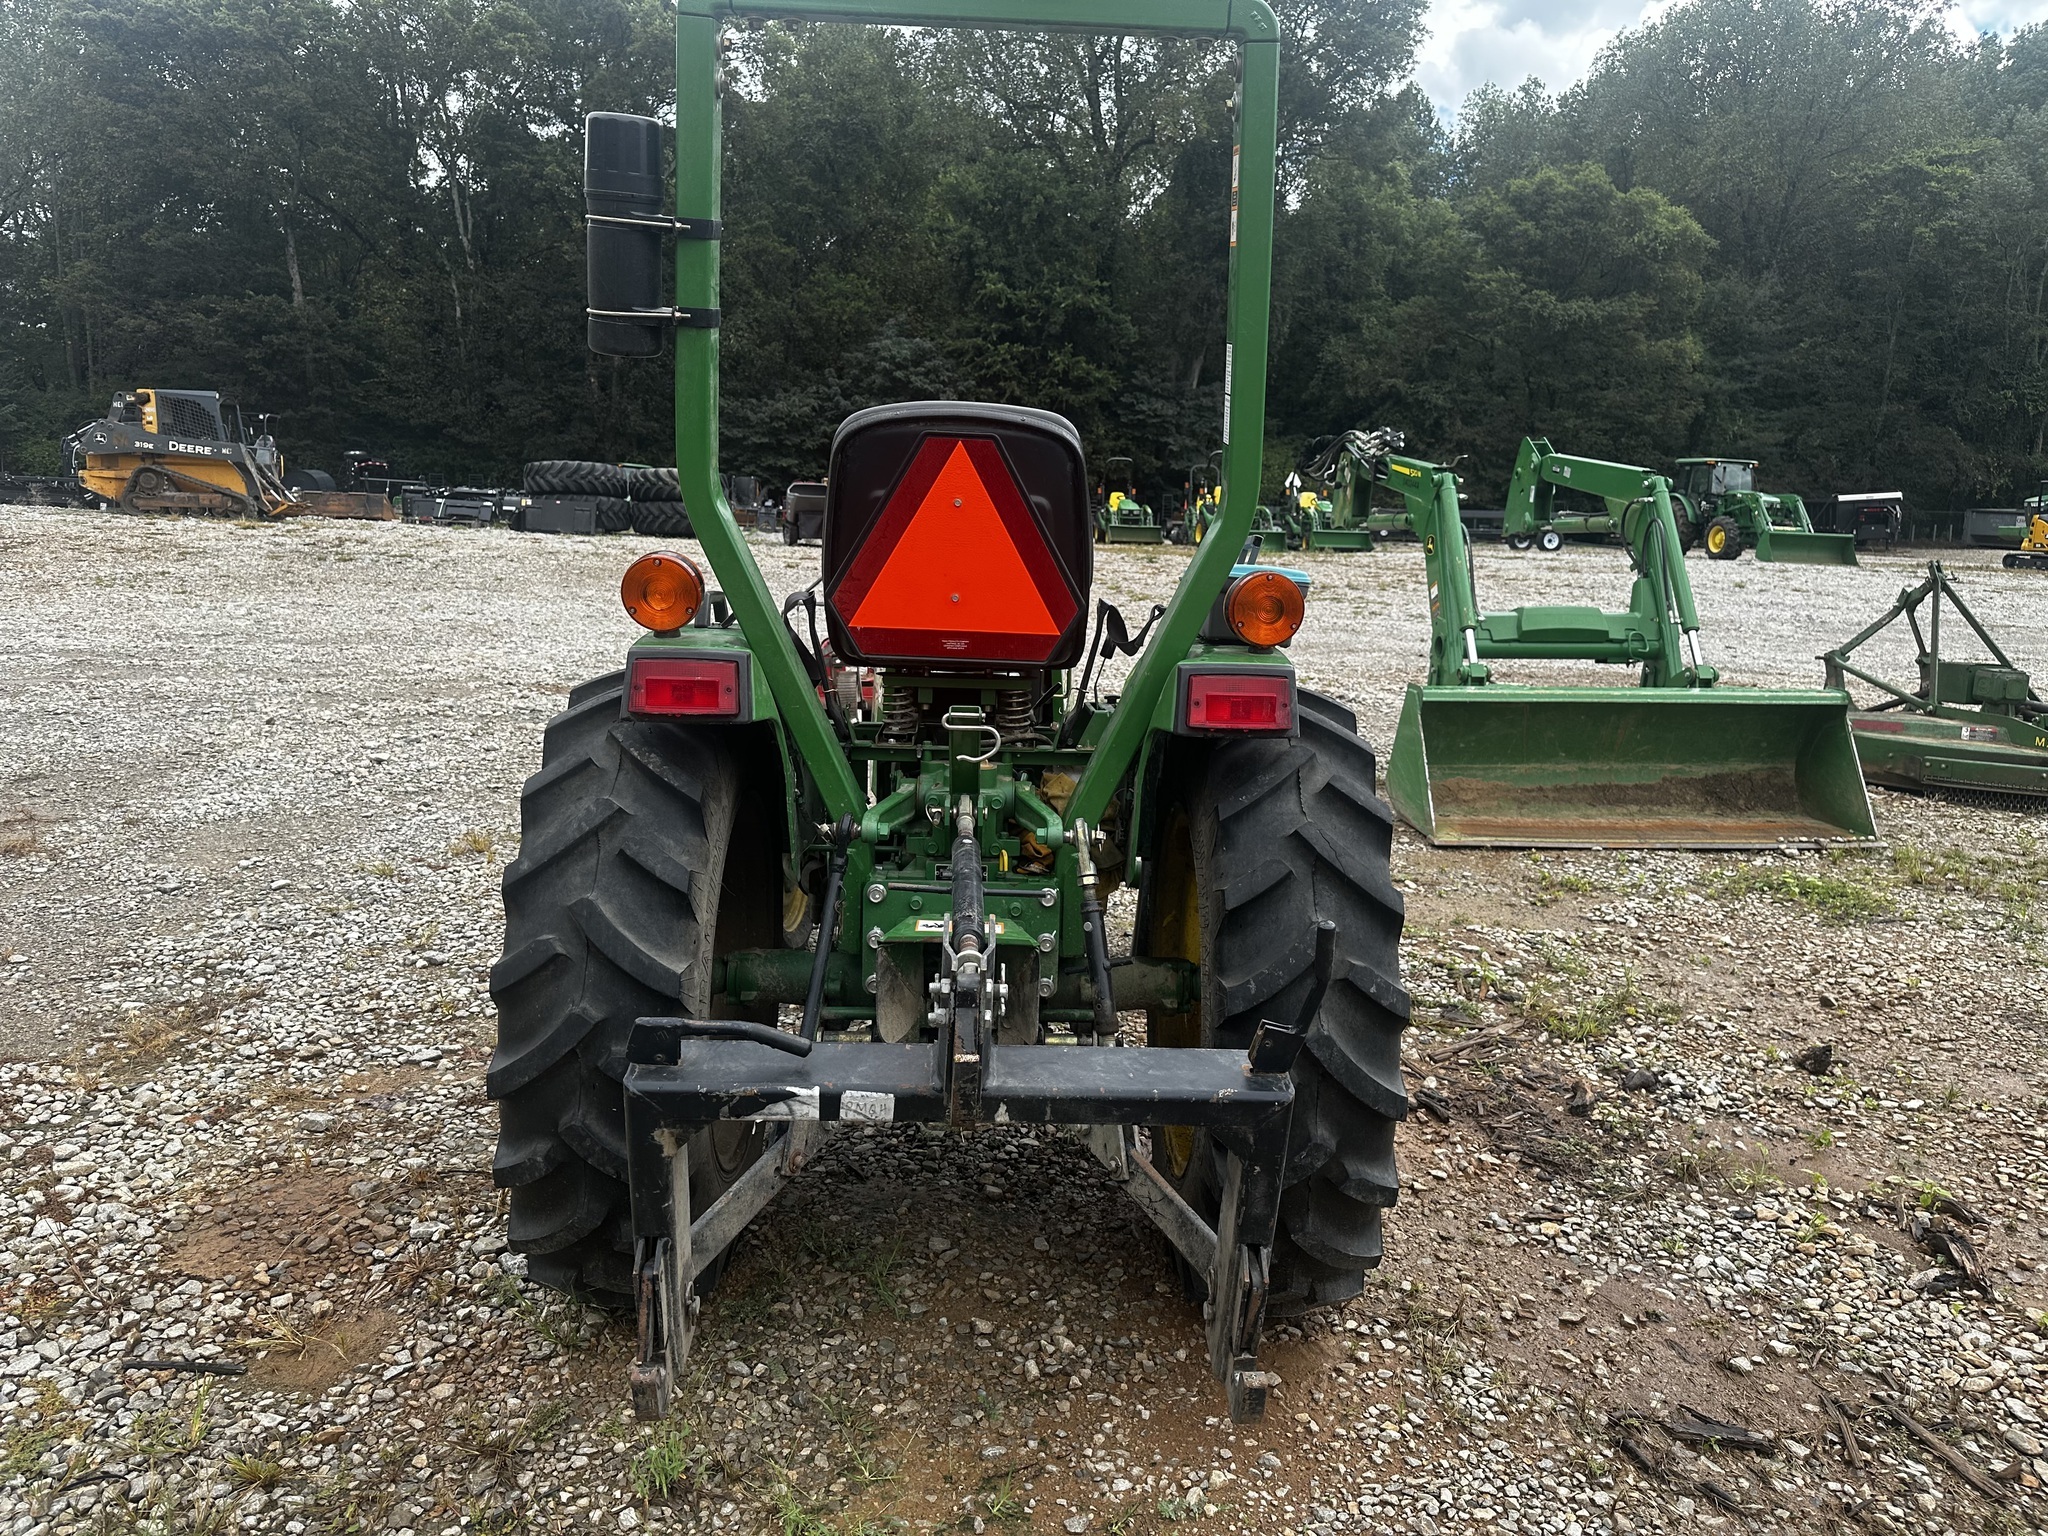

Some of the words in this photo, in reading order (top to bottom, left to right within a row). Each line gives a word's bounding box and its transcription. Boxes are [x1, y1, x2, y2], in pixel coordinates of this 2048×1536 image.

[134, 440, 154, 450] 319E
[168, 440, 213, 456] DEERE
[2034, 736, 2048, 748] M
